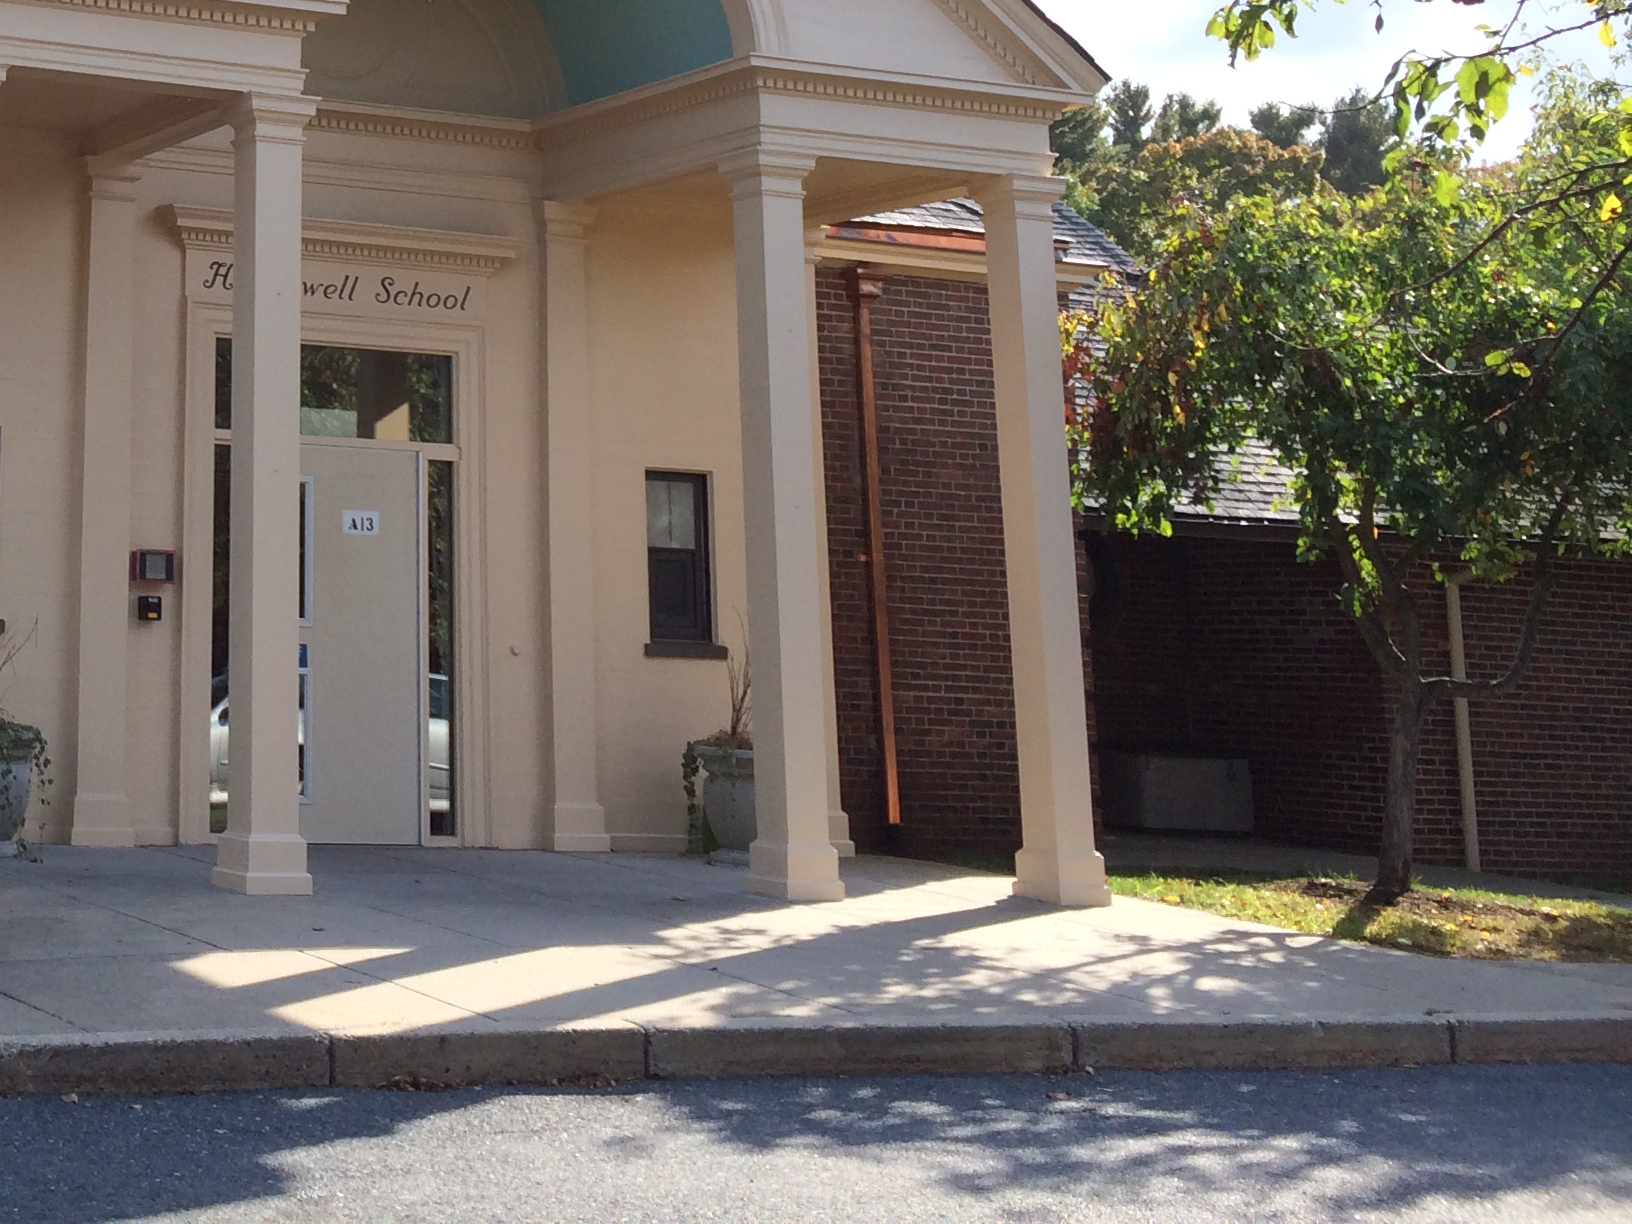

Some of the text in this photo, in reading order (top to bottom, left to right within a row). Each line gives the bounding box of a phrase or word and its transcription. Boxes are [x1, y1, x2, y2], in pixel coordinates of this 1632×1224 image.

[202, 260, 471, 311] Hwell School
[348, 516, 374, 532] A13
